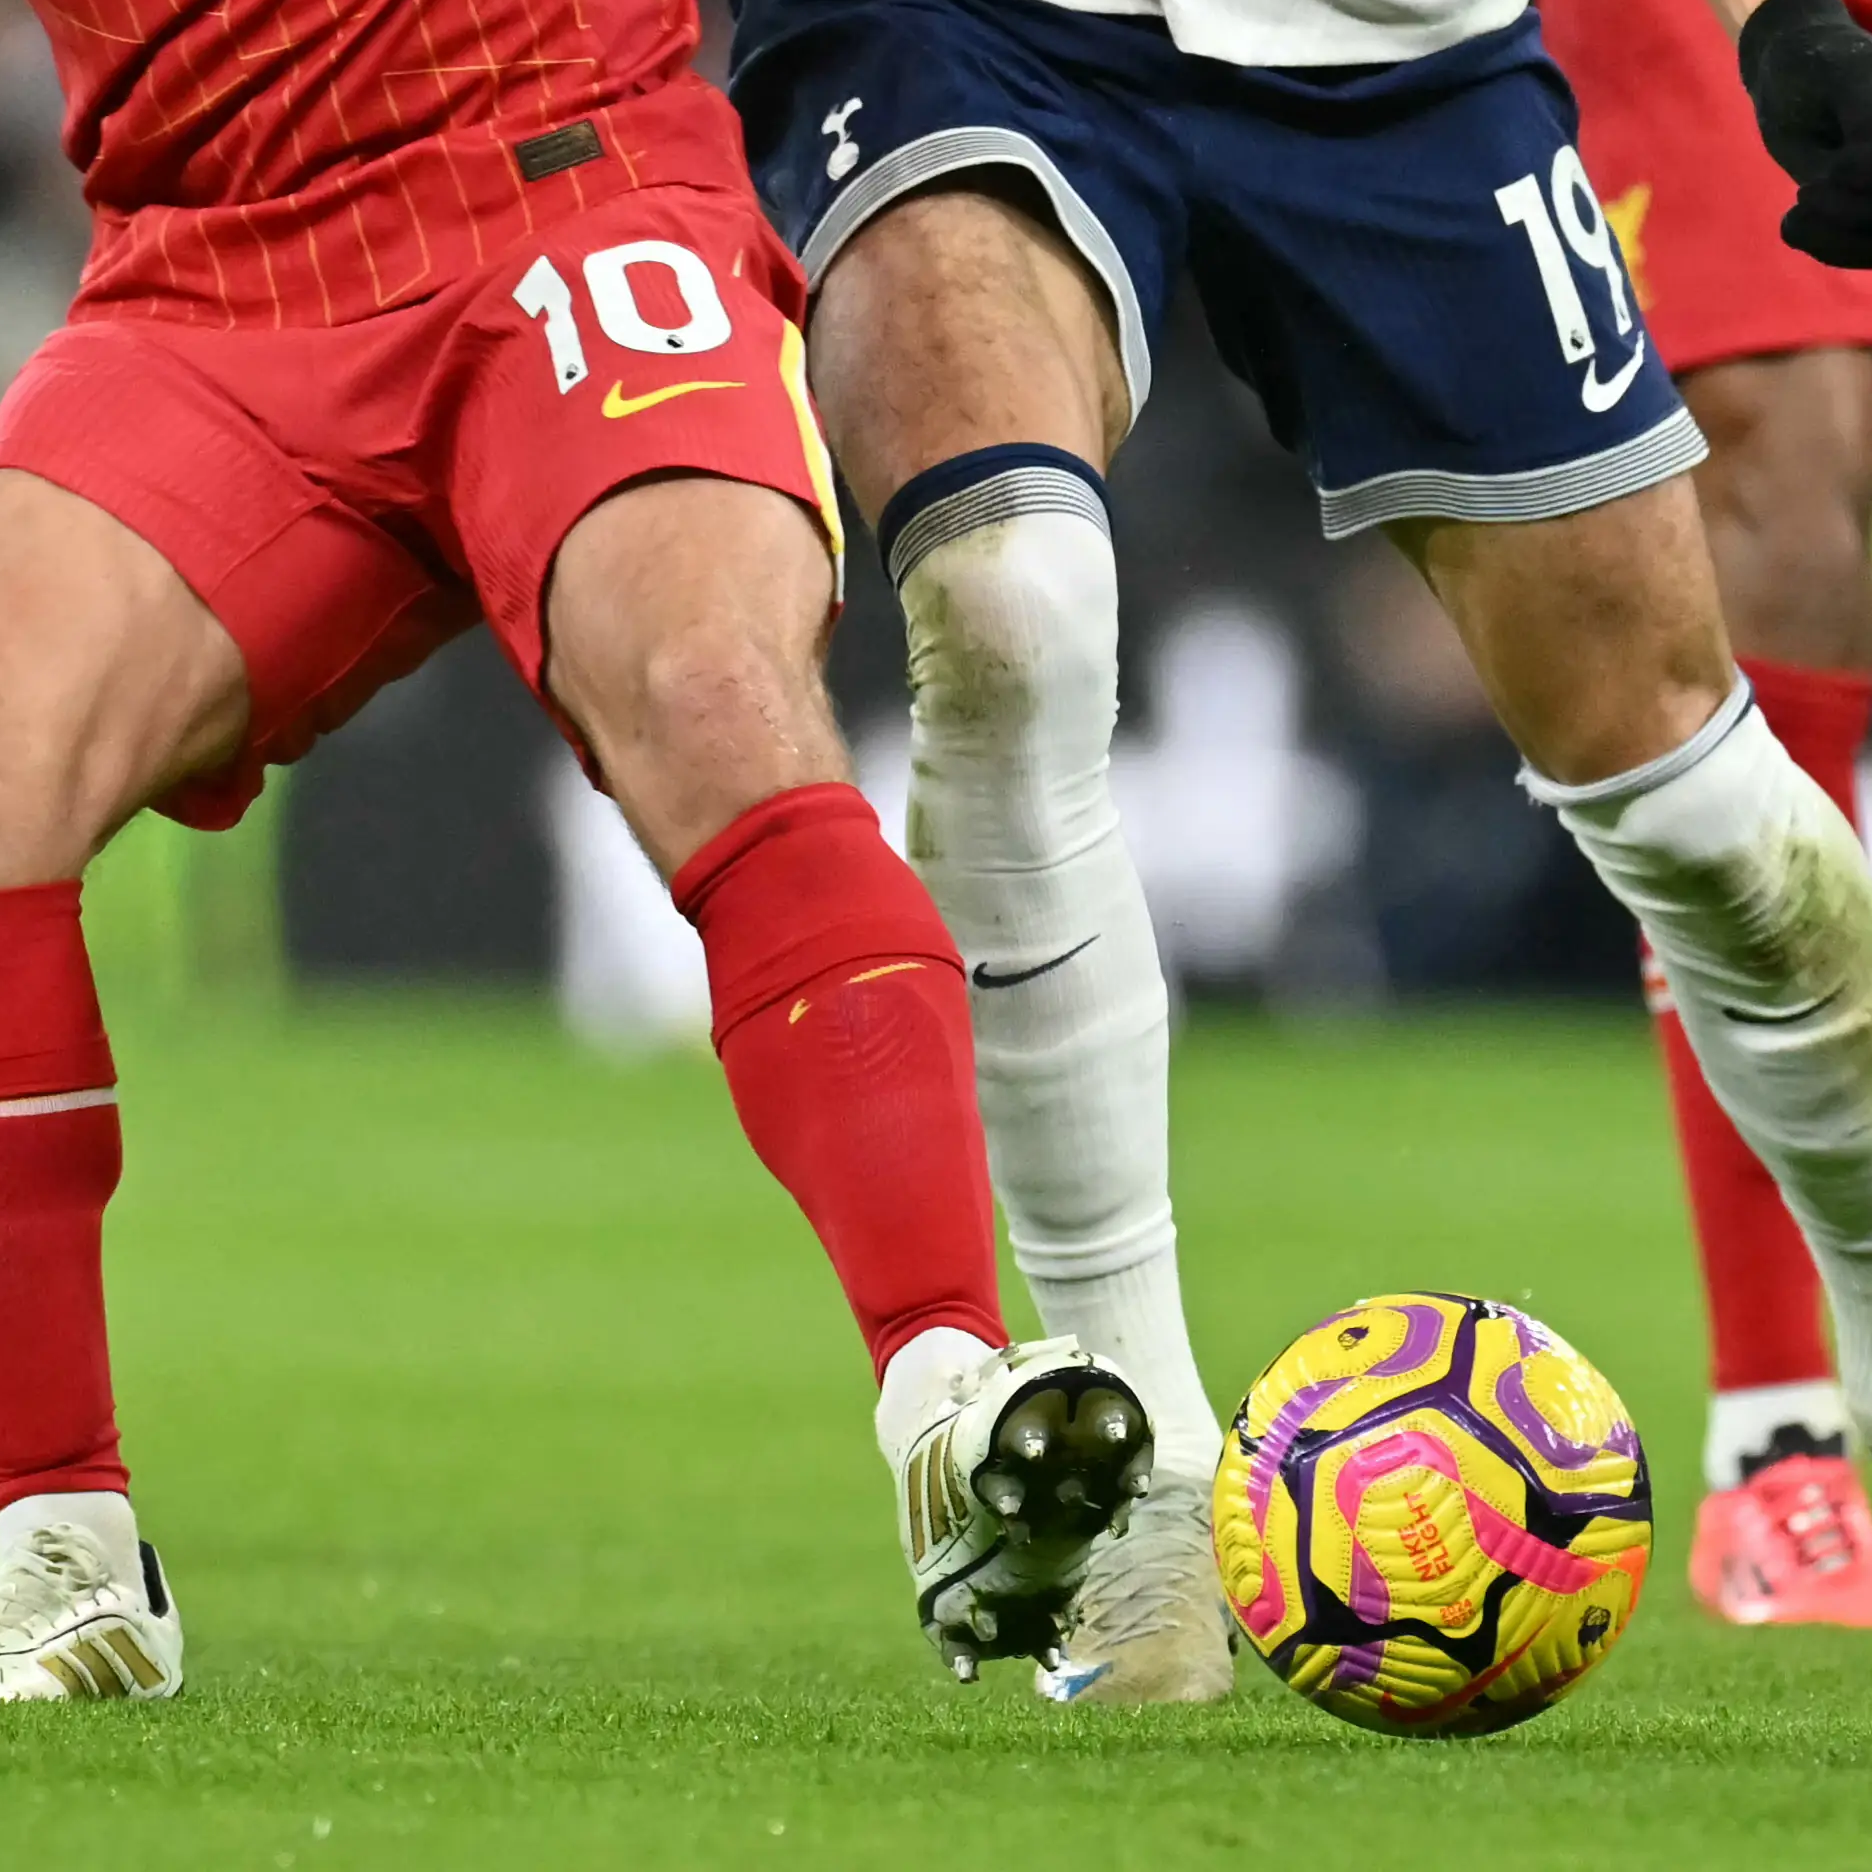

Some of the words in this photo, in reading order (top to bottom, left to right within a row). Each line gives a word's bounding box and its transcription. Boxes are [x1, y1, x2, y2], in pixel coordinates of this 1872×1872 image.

[1493, 144, 1633, 365] 19
[512, 239, 733, 396] 10
[1397, 1523, 1437, 1583] NIKE
[1403, 1492, 1455, 1576] FLIGHT
